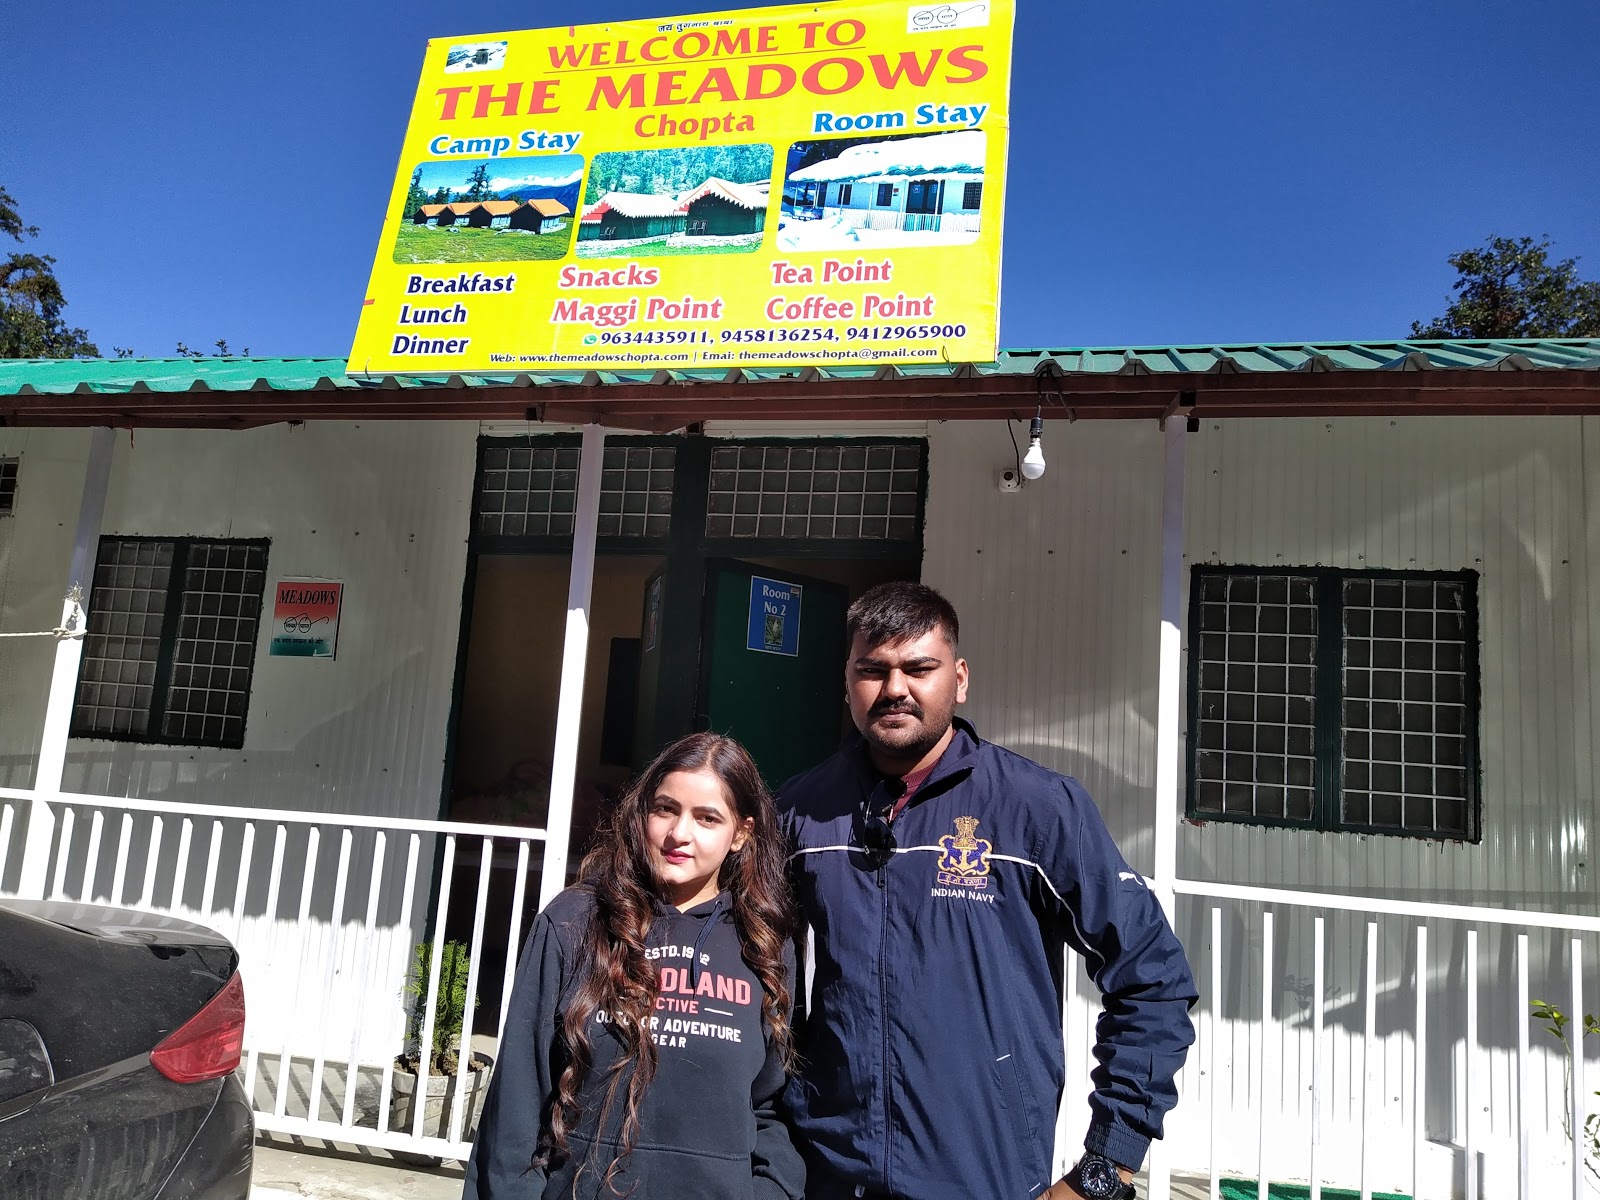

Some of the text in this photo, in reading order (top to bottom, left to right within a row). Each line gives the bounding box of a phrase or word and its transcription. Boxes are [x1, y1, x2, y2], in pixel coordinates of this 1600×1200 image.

[547, 19, 866, 69] WELCOME TO
[435, 45, 989, 121] THE MEADOWS
[634, 112, 755, 141] Chopta
[814, 104, 987, 133] Room Stay
[430, 131, 581, 156] Camp Stay
[560, 265, 658, 287] Snacks
[772, 260, 891, 284] Tea Point
[407, 274, 515, 293] Breakfast
[400, 304, 467, 324] Lunch
[552, 298, 723, 326] Maggi Point
[767, 294, 934, 320] Coffee Point
[392, 335, 469, 355] Dinner
[601, 324, 966, 345] 9634435911, 9458136254, 9412965900
[490, 353, 515, 363] Web:
[519, 352, 689, 364] www.themeadowschopta.com
[702, 351, 735, 361] Emai:
[739, 348, 937, 361] themeadowschopta@gmail.com
[279, 590, 336, 605] MEADOWS
[763, 585, 790, 600] Room
[764, 601, 786, 615] No 2
[931, 888, 994, 903] INDIAN NAVY
[661, 967, 751, 1005] DLAND
[655, 997, 699, 1014] CTIVE
[651, 1033, 687, 1048] GEAR
[663, 1018, 741, 1043] ADVENTURE
